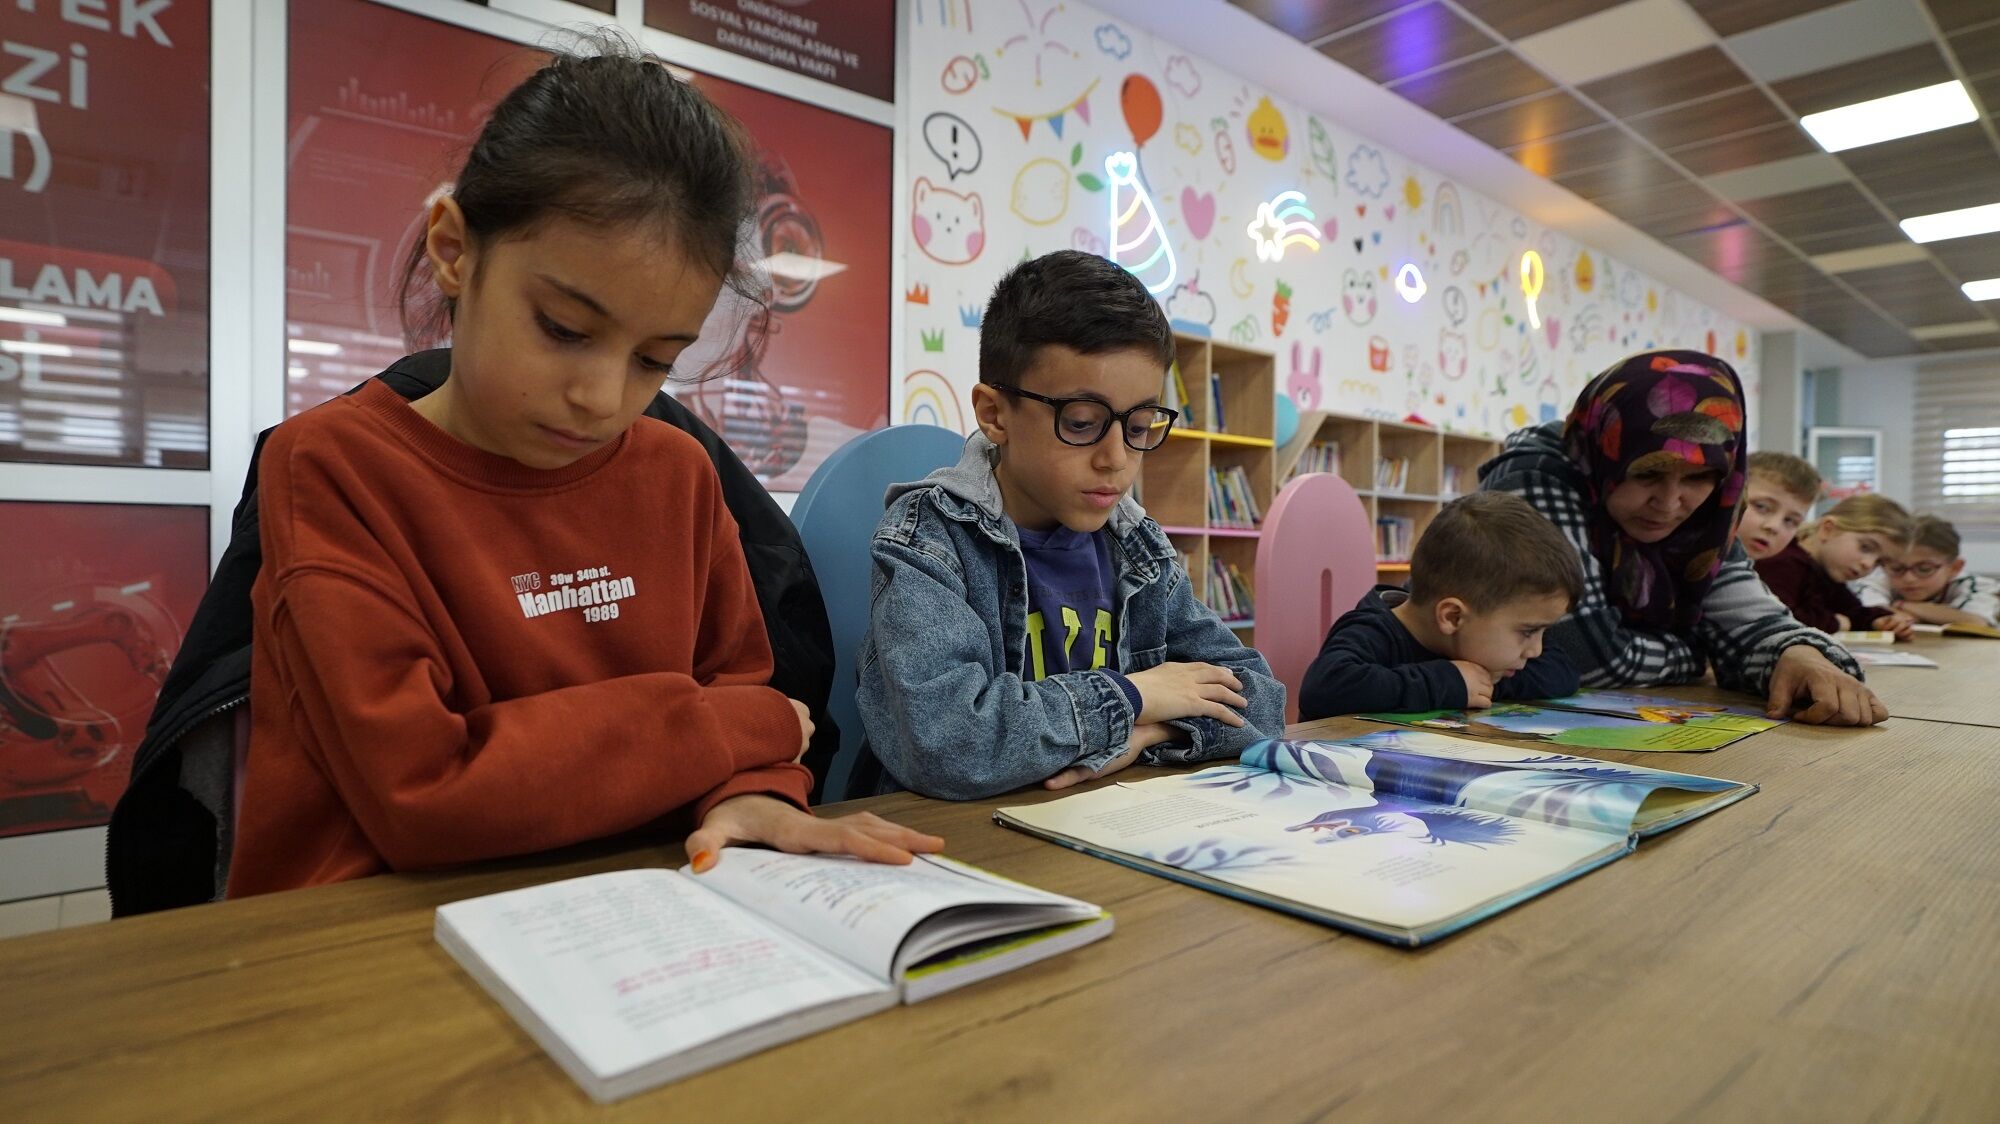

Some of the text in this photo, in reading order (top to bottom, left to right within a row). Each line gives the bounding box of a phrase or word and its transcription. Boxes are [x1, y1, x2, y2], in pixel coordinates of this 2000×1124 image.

[689, 0, 744, 30] SOSYAL
[841, 50, 860, 69] VE
[576, 567, 599, 582] 34th
[517, 576, 636, 618] Manhattan
[582, 602, 620, 623] 1989
